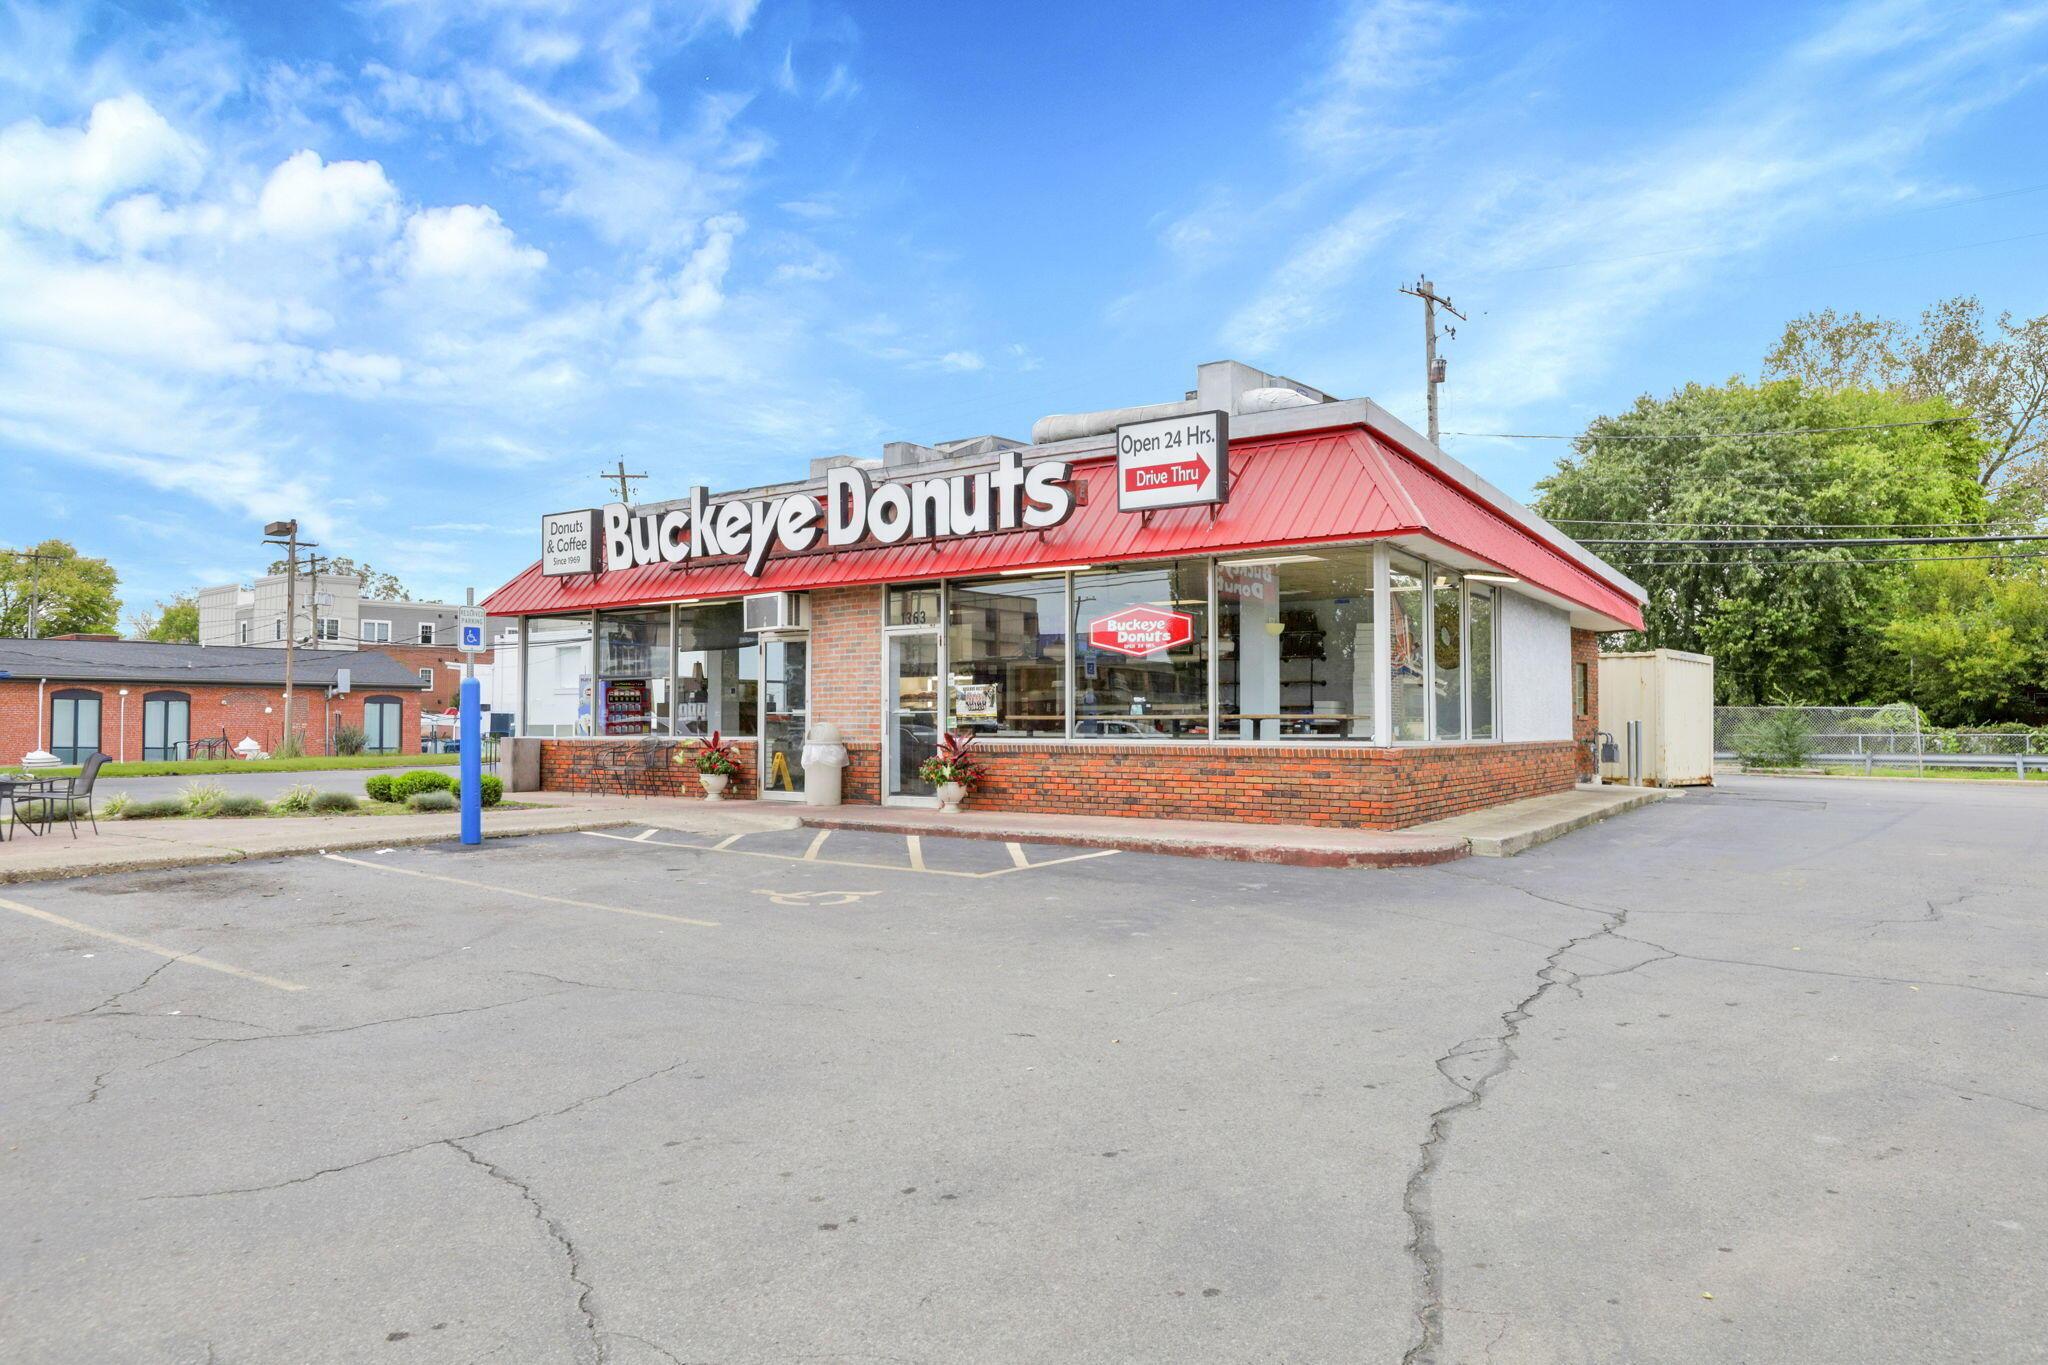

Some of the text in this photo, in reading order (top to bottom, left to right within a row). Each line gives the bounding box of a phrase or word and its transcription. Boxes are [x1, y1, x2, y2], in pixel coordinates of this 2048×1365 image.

[1121, 425, 1215, 456] Open 24 Hrs.
[1136, 466, 1199, 486] Drive Thru
[603, 451, 1073, 577] Buckeye Donuts
[550, 520, 583, 535] Donuts
[547, 536, 587, 553] & Coffee
[1107, 619, 1165, 632] Buckeye
